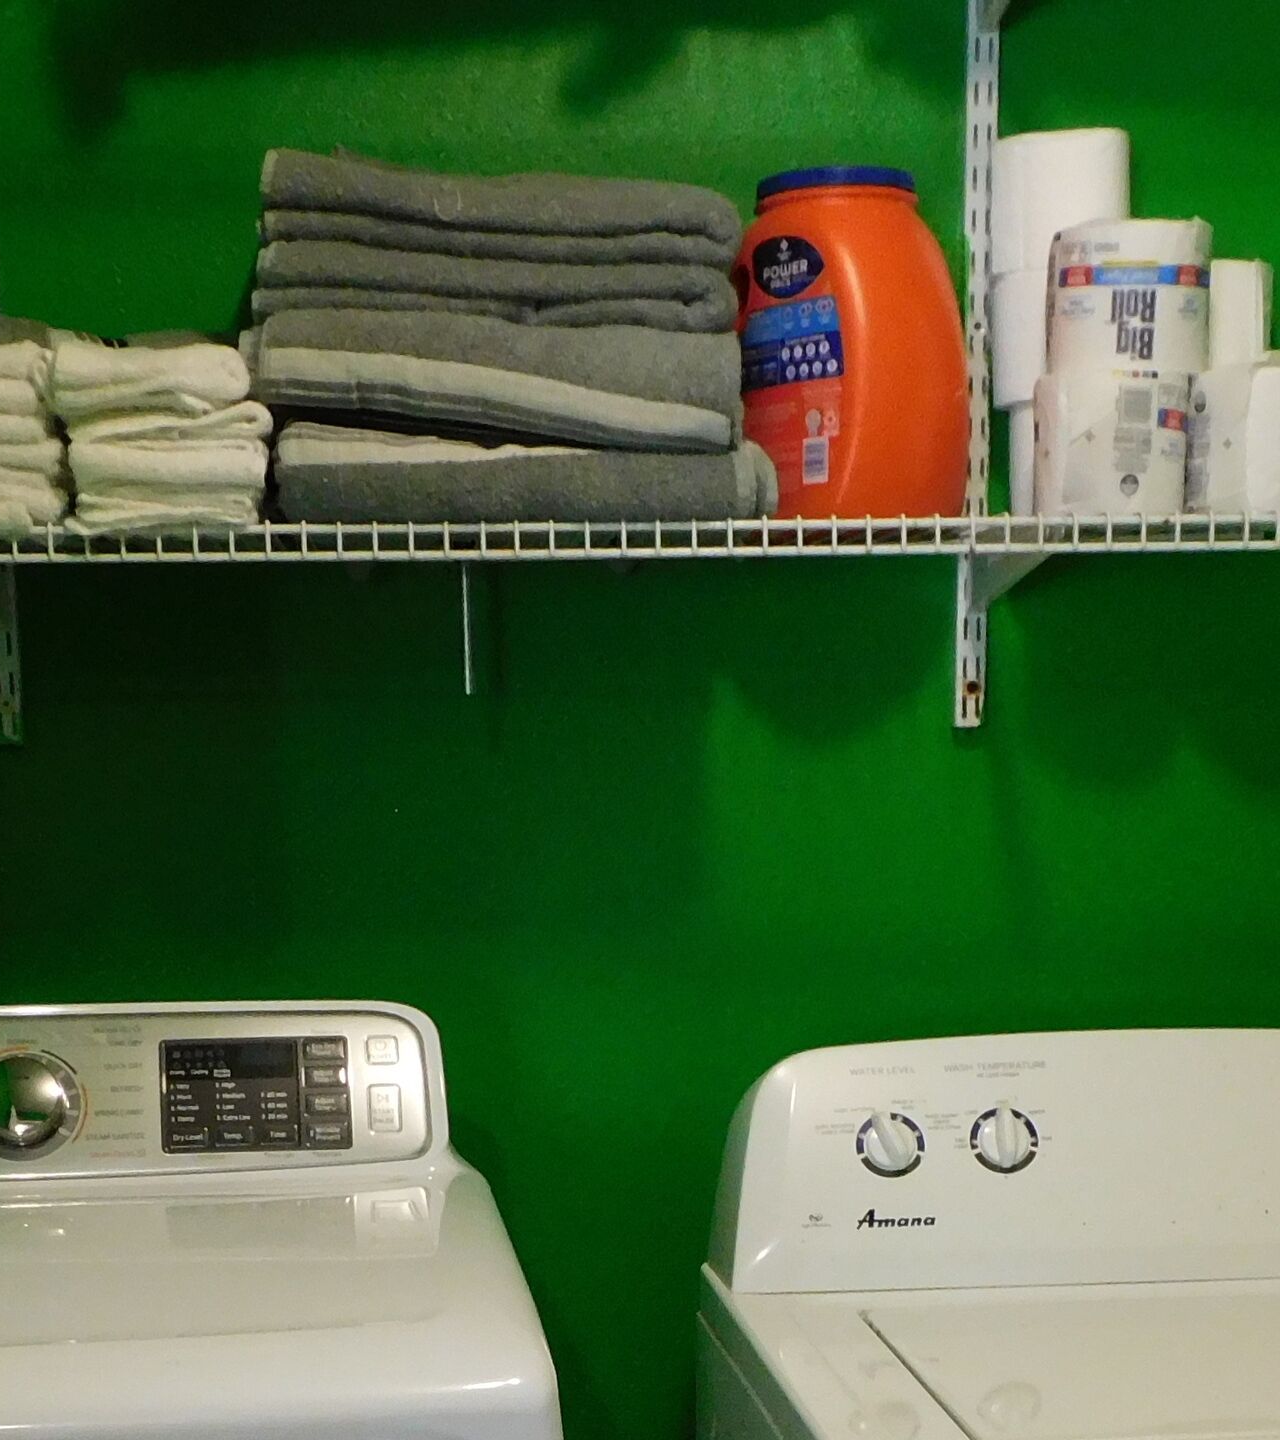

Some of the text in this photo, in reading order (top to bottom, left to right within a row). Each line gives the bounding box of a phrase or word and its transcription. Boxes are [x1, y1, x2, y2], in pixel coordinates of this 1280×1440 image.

[763, 258, 809, 281] POWER
[1110, 289, 1157, 323] Roll
[1115, 321, 1155, 360] Big
[856, 1209, 936, 1230] Amana
